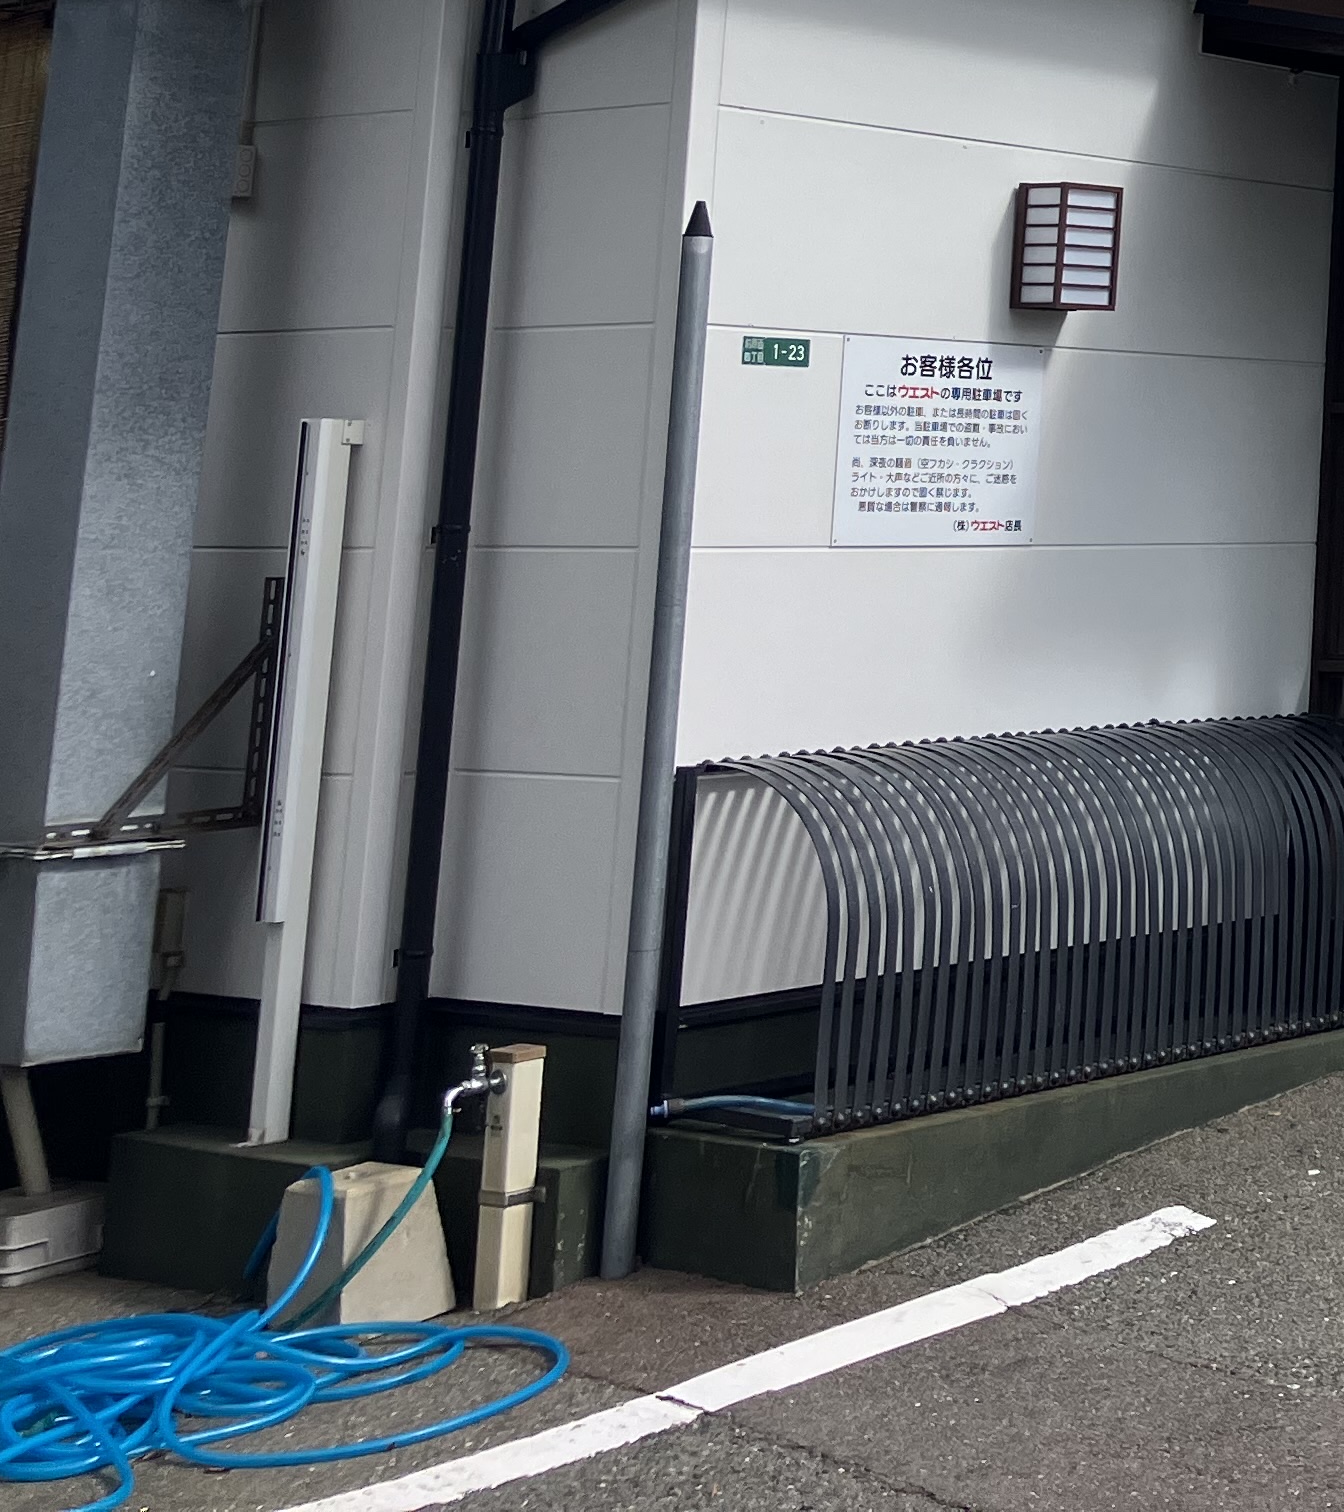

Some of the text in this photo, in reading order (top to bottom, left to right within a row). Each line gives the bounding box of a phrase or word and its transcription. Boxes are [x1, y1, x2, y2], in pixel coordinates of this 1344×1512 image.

[773, 343, 805, 361] 1-23
[900, 354, 994, 381] お客様各位
[864, 384, 1024, 403] ここはウエストの専用駐車場です
